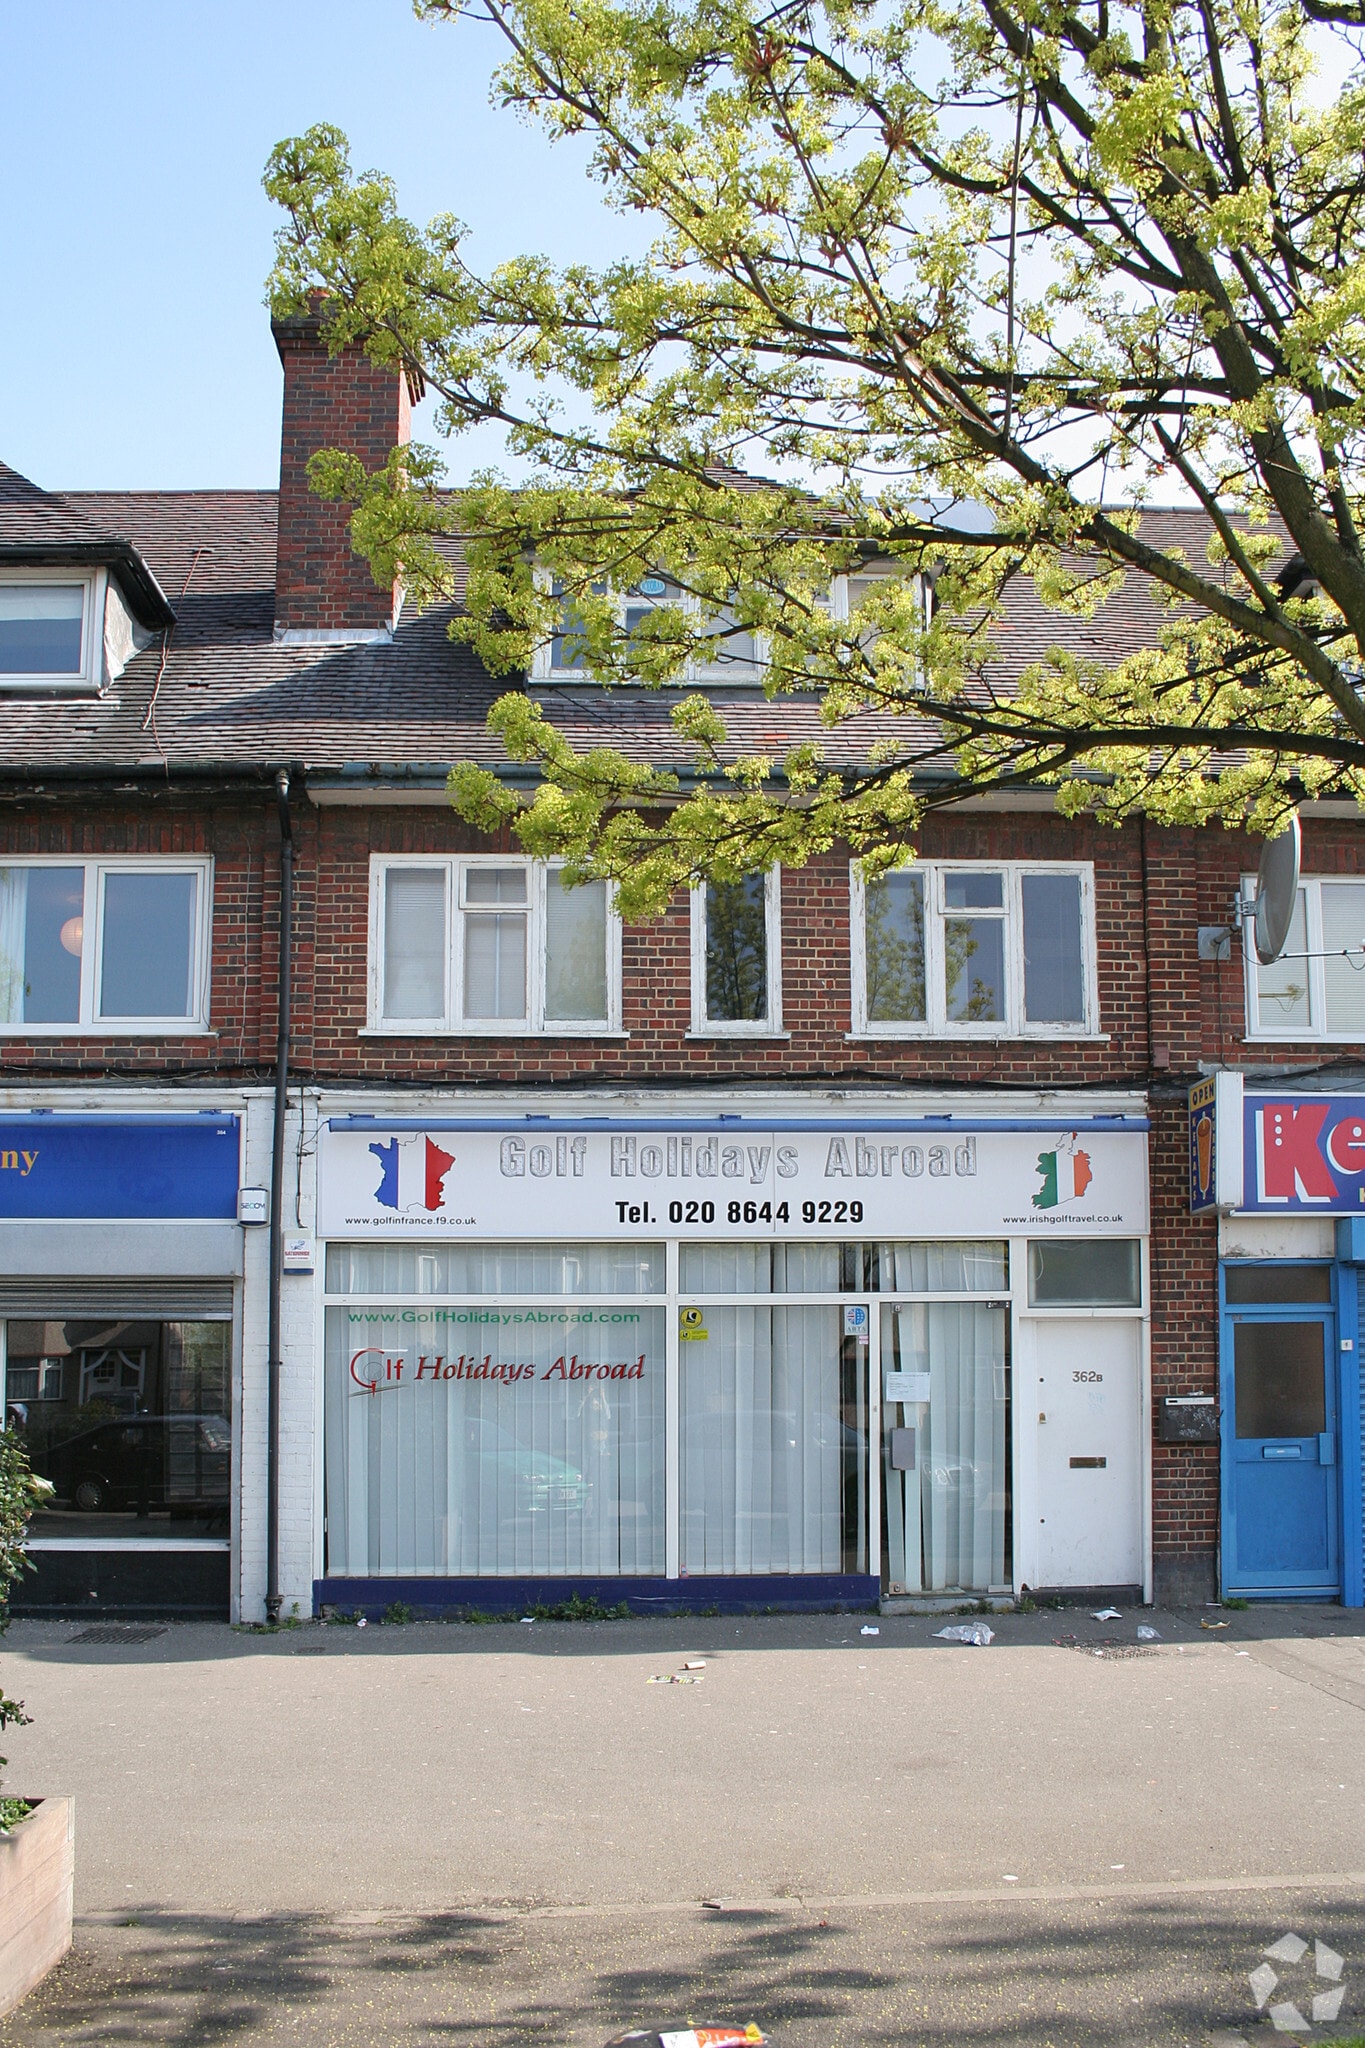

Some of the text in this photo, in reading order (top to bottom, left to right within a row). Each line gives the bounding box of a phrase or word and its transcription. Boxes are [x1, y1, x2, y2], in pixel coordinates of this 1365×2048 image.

[1192, 1085, 1214, 1106] OPEN
[499, 1136, 978, 1184] Golf Holidays Abroad
[240, 1202, 266, 1210] SECOM
[615, 1201, 865, 1224] Tel. 020 8644 9229
[345, 1216, 477, 1226] www.golfinfrance.f9.co.uk
[1003, 1214, 1123, 1224] www.irishgolftravel.co.uk
[348, 1311, 640, 1325] www.GolfHolidaysAbroad.com
[414, 1353, 537, 1386] Holidays
[540, 1353, 646, 1381] Abroad
[1072, 1370, 1103, 1383] 362B
